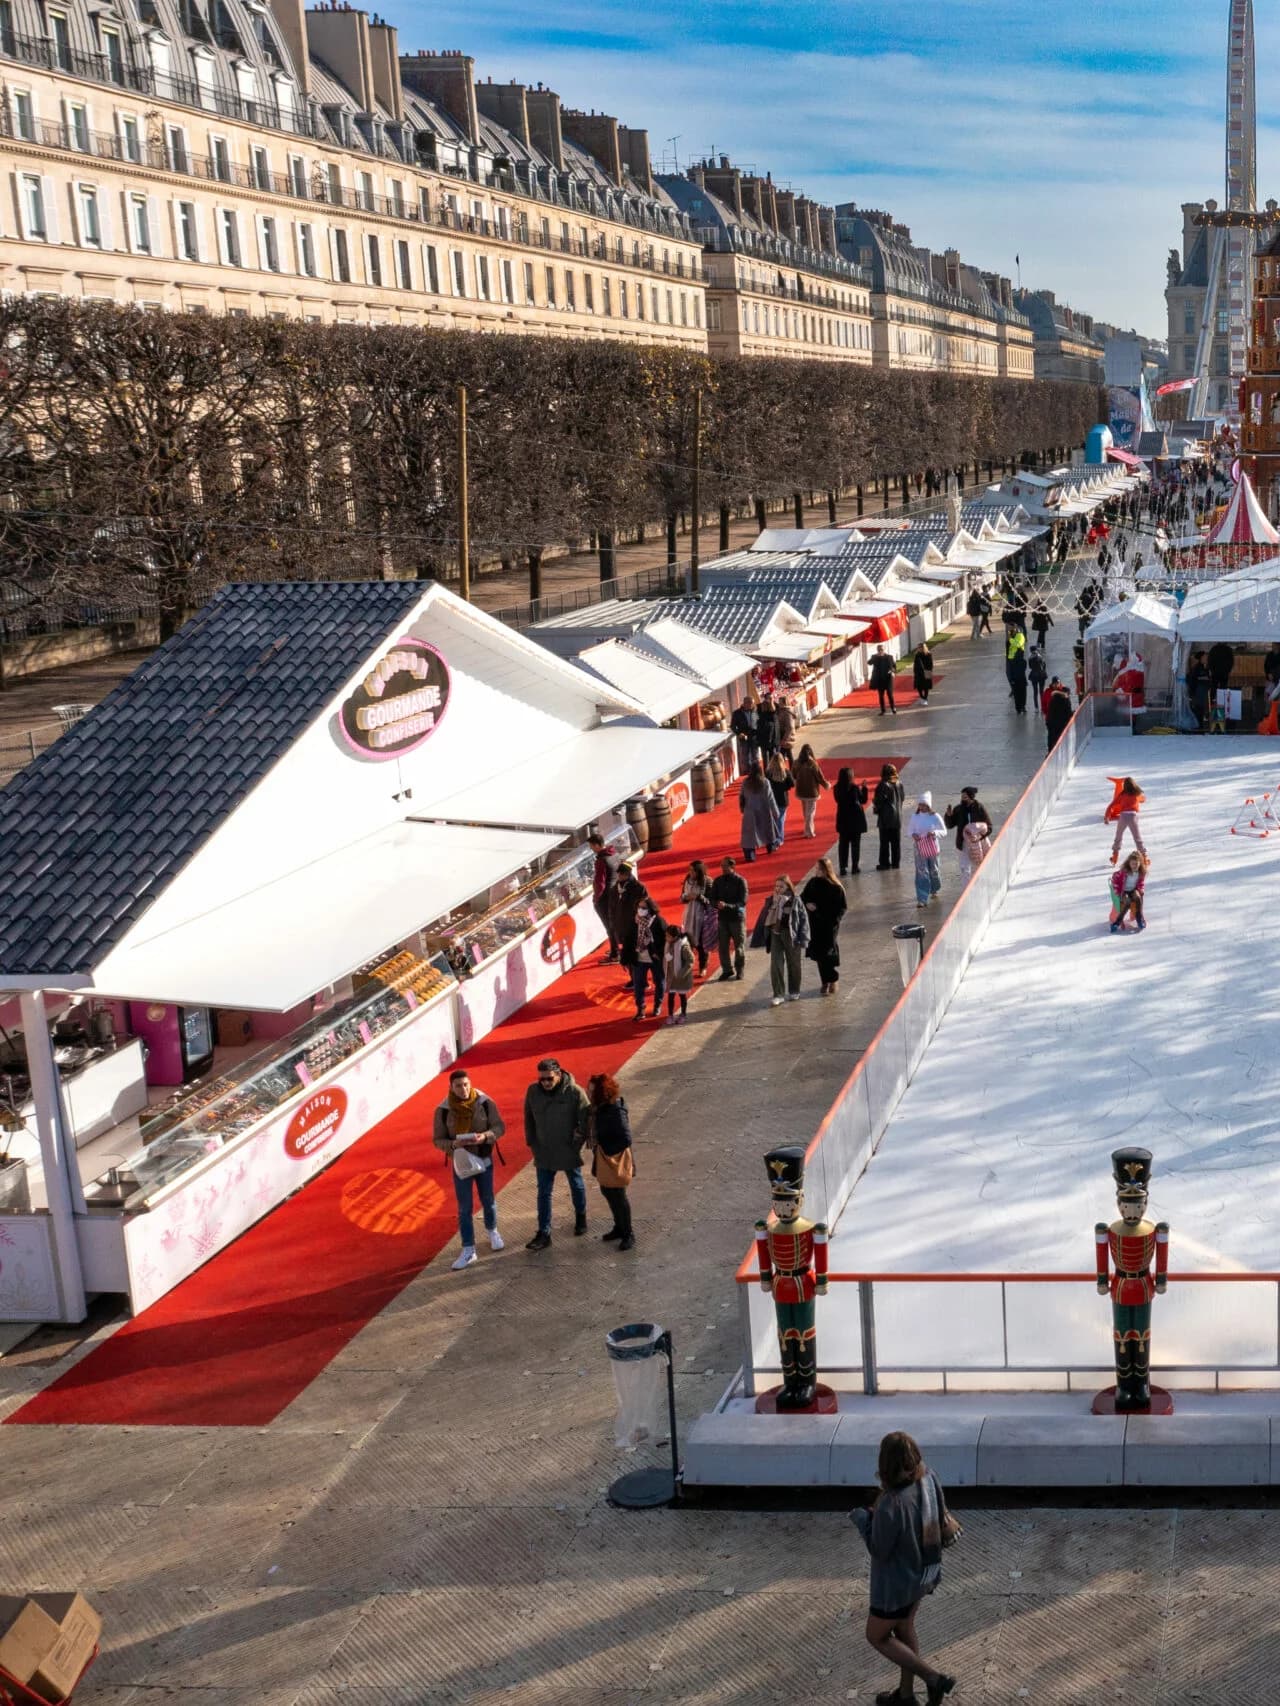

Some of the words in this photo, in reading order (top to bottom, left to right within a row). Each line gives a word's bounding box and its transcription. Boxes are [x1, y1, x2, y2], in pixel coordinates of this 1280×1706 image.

[357, 685, 442, 730] GOURMANDE
[369, 712, 435, 748] CONFISERIE
[295, 1108, 340, 1149] GOURMANDE
[299, 1095, 332, 1128] MAISON
